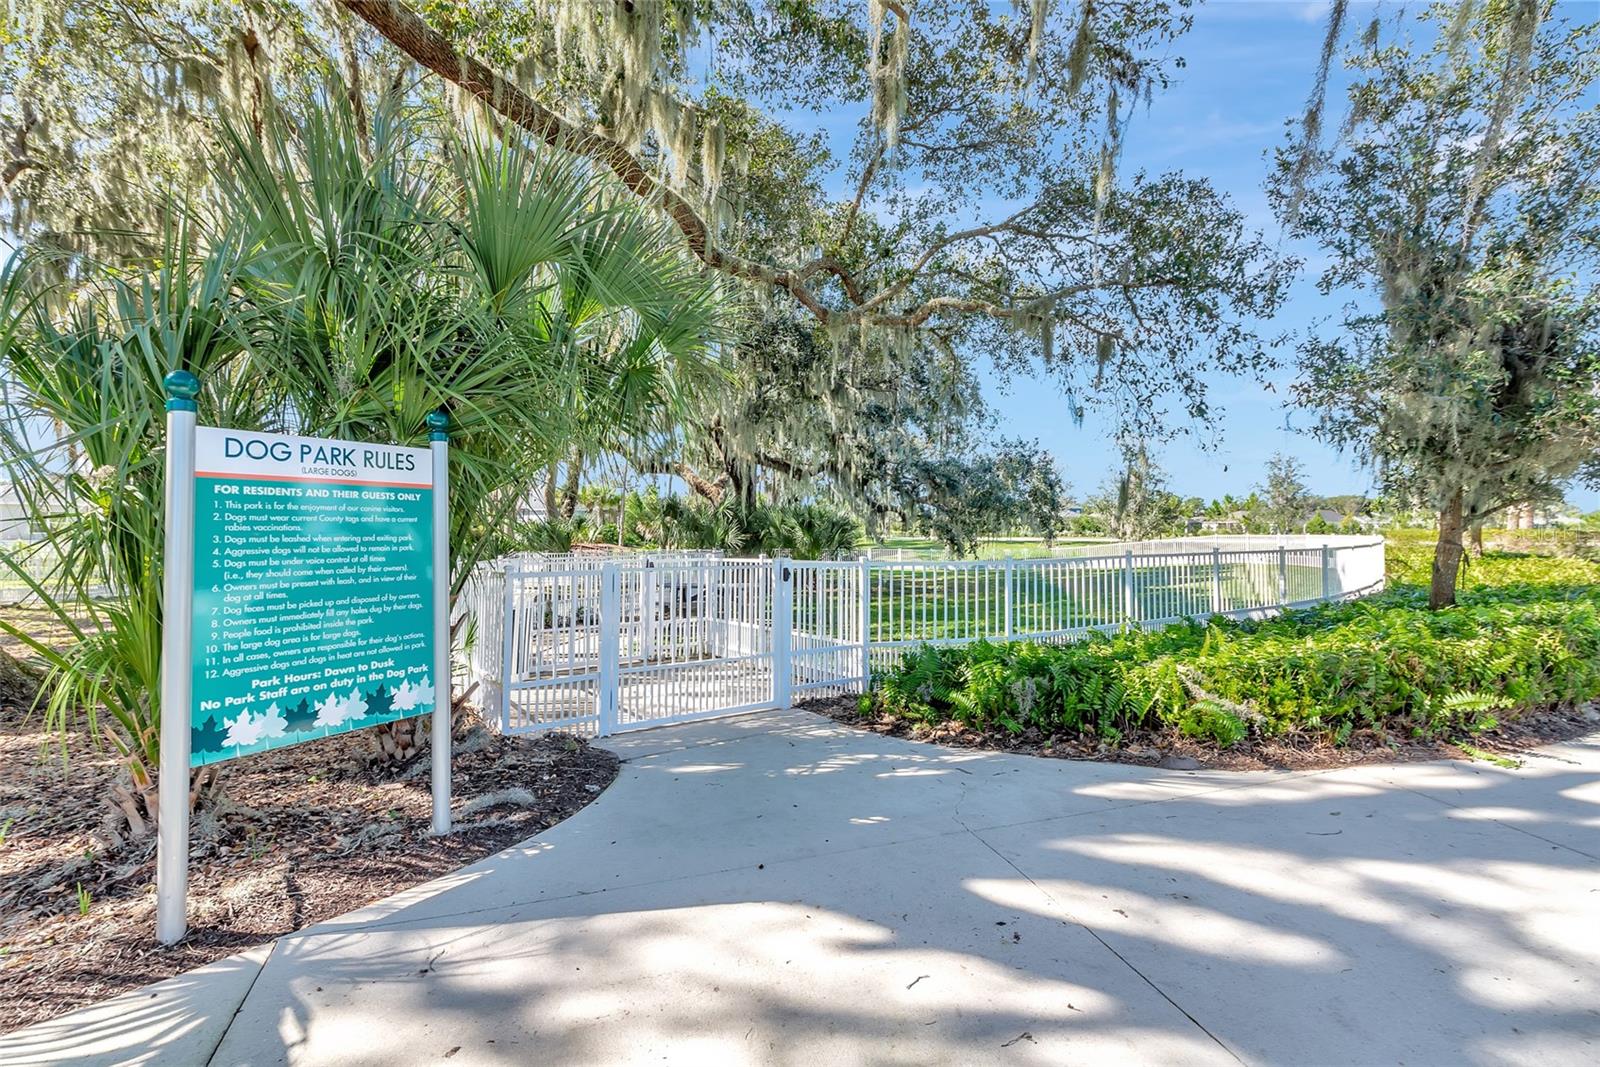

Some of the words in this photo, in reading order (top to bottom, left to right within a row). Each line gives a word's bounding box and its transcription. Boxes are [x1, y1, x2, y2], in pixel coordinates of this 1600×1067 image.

[225, 438, 292, 461] DOG
[300, 444, 356, 466] PARK
[364, 450, 415, 471] RULES
[302, 467, 329, 475] (LARGE
[214, 486, 239, 494] FOR
[243, 486, 302, 496] RESIDENTS
[332, 490, 359, 498] THEIR
[225, 501, 241, 509] This
[244, 502, 263, 511] park
[287, 502, 299, 510] the
[225, 513, 246, 522] Dogs
[224, 523, 251, 531] rabies
[224, 536, 246, 545] Dogs
[224, 547, 270, 557] Aggressive
[272, 546, 291, 556] dogs
[224, 560, 246, 569] Dogs
[269, 557, 280, 566] be
[246, 570, 263, 579] they
[266, 568, 291, 577] should
[358, 566, 366, 574] by
[212, 584, 221, 592] 6.
[224, 584, 257, 592] Owners
[292, 580, 319, 589] present
[224, 594, 240, 603] dog
[299, 599, 323, 609] picked
[336, 597, 350, 605] and
[351, 594, 380, 604] disposed
[223, 619, 257, 627] Owners
[279, 611, 324, 621] immediately
[383, 604, 392, 613] by
[223, 629, 252, 639] People
[254, 626, 272, 635] food
[284, 621, 322, 634] prohibited
[323, 618, 344, 628] inside
[223, 643, 238, 651] The
[241, 641, 262, 650] large
[264, 638, 280, 647] dog
[323, 632, 341, 640] large
[206, 658, 220, 666] 11.
[233, 653, 244, 662] all
[246, 653, 271, 661] cases,
[317, 639, 356, 652] responsible
[358, 638, 367, 646] for
[205, 670, 220, 679] 12.
[222, 664, 268, 677] Aggressive
[271, 661, 290, 670] dogs
[292, 657, 307, 667] and
[308, 656, 326, 664] dogs
[378, 644, 403, 653] allowed
[252, 677, 280, 689] Park
[284, 672, 321, 684] Hours:
[324, 666, 355, 677] Dawn
[371, 658, 395, 669] Dusk
[201, 700, 221, 711] No
[225, 693, 255, 706] Park
[260, 687, 288, 701] Staff
[290, 684, 310, 695] are
[330, 678, 354, 688] duty
[357, 675, 366, 683] in
[369, 672, 384, 681] the
[387, 670, 405, 678] Dog
[408, 664, 429, 674] Park
